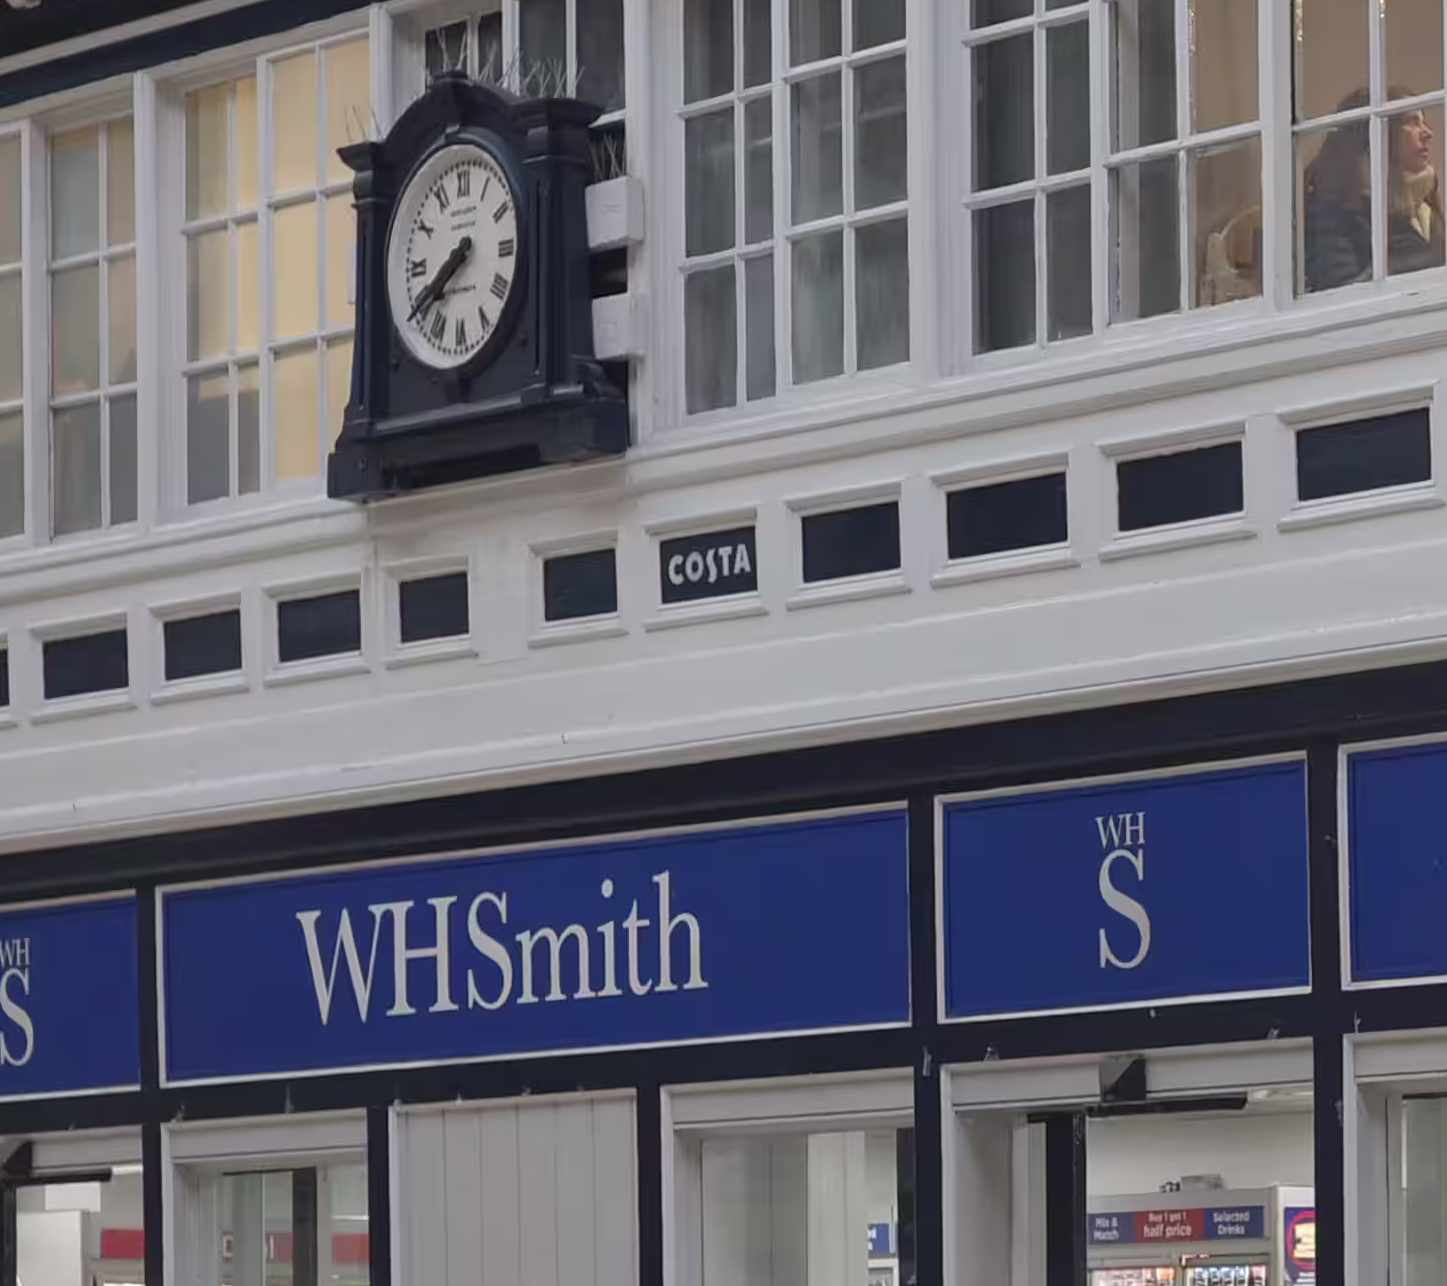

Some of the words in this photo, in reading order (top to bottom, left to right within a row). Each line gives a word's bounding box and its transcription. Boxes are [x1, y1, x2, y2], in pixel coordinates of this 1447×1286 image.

[668, 543, 752, 586] COSTA
[1095, 810, 1146, 850] WH
[1098, 850, 1151, 970] S
[296, 870, 709, 1026] WHSmith
[0, 968, 35, 1067] S
[1143, 1224, 1163, 1238] half
[1165, 1222, 1192, 1239] price
[1217, 1223, 1245, 1236] Drinks
